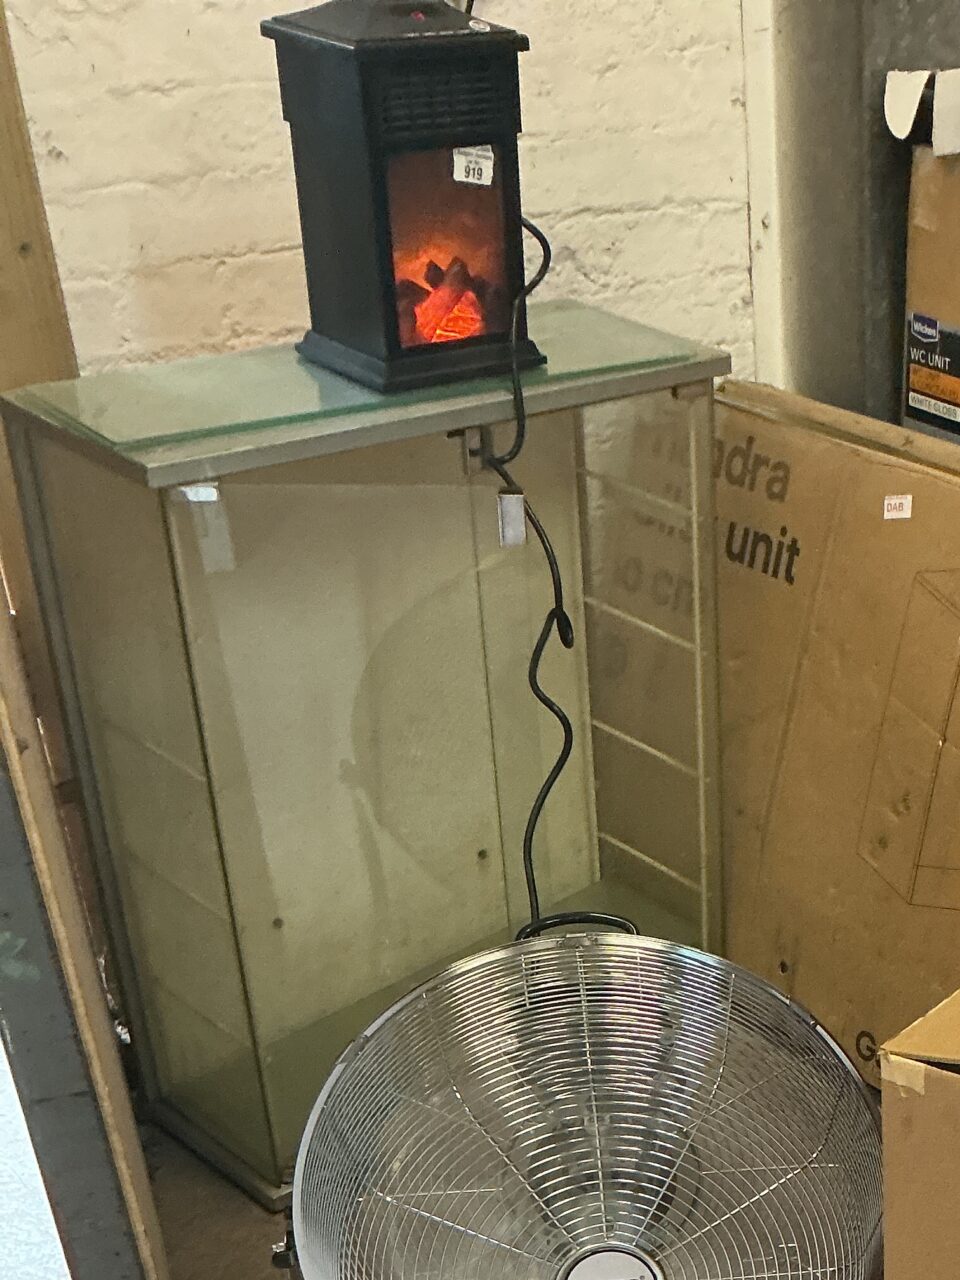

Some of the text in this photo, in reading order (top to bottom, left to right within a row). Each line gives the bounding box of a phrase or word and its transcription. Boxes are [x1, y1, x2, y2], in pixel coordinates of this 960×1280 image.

[464, 165, 483, 180] 919
[910, 347, 951, 371] WC UNIT
[725, 520, 800, 586] unit
